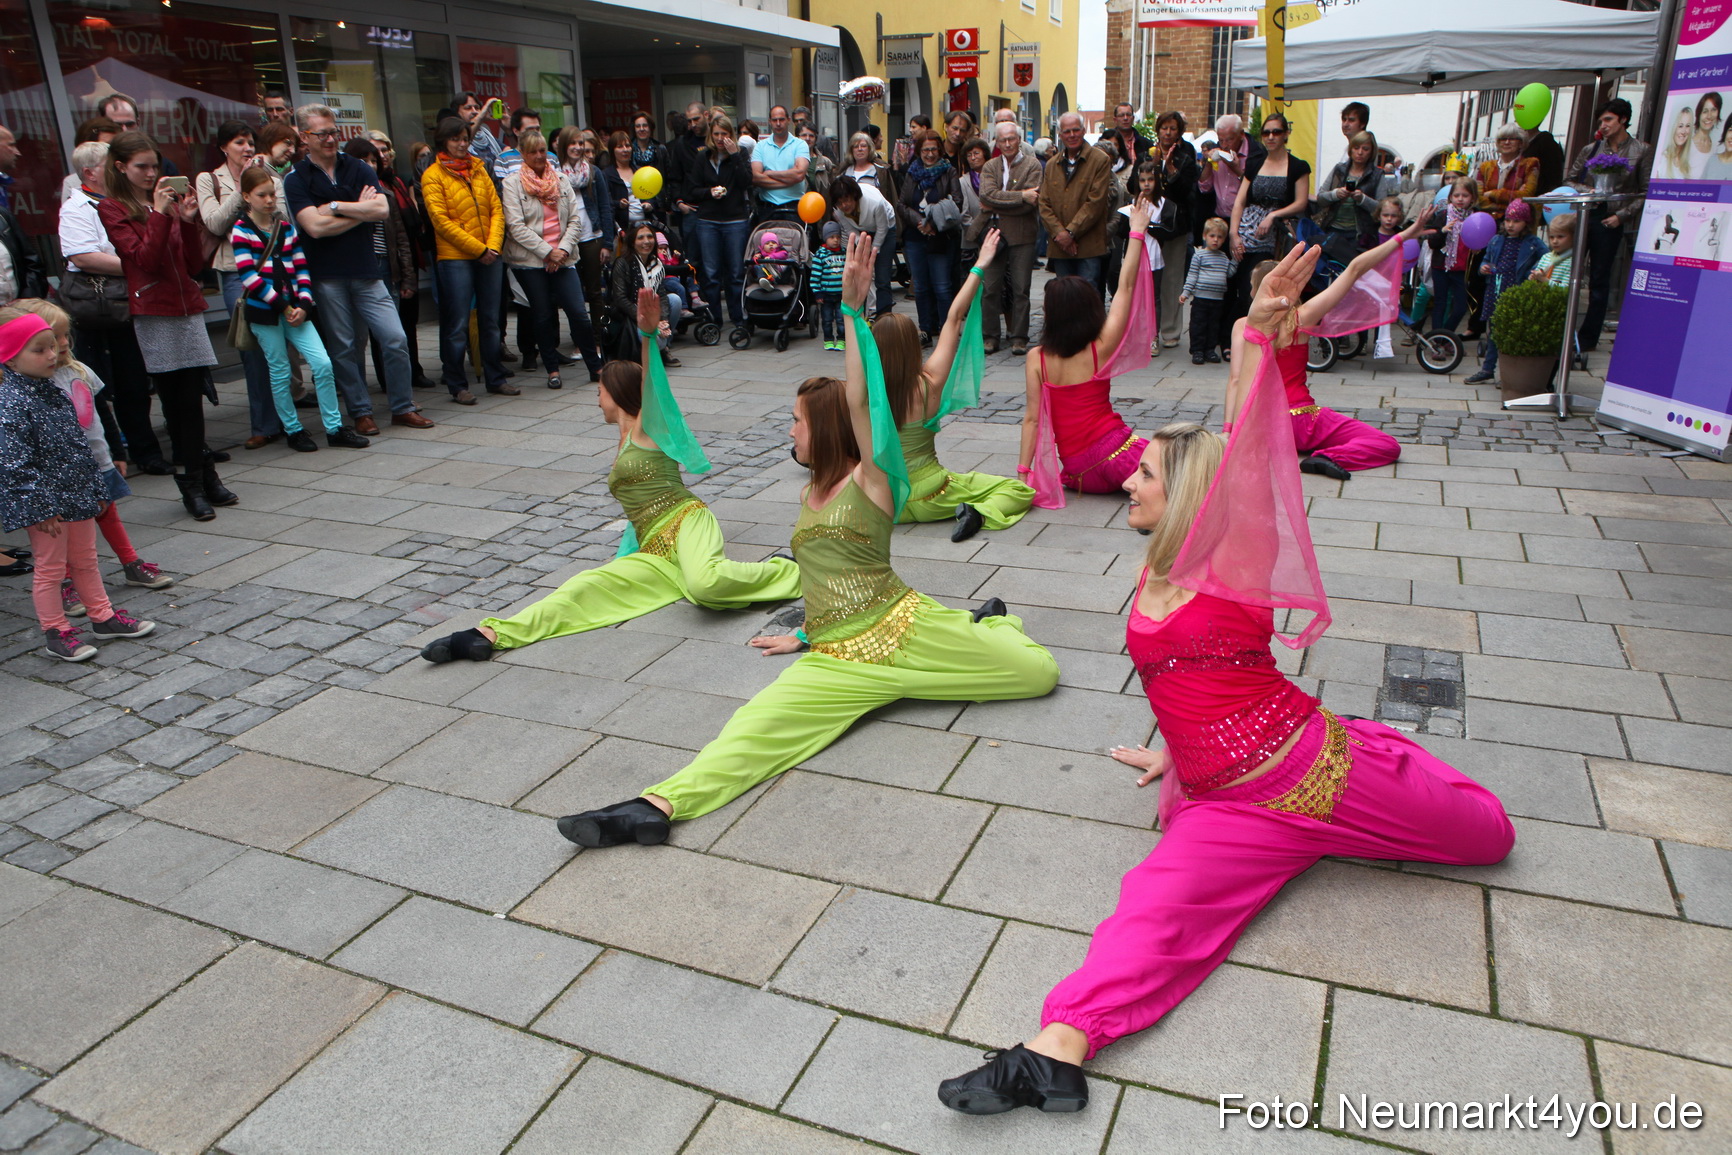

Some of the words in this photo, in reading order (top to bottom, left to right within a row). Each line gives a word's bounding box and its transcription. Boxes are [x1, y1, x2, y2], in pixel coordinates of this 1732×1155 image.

[1142, 6, 1168, 15] Langer
[1169, 5, 1233, 14] Einkaufssamstag
[1234, 4, 1247, 12] mit
[110, 29, 176, 58] TOTAL
[184, 36, 244, 63] TOTAL
[887, 51, 912, 62] SARAH
[913, 49, 920, 61] K
[473, 60, 506, 78] ALLES
[474, 80, 508, 98] MUSS
[604, 88, 639, 99] ALLES
[322, 97, 342, 107] TOTAL
